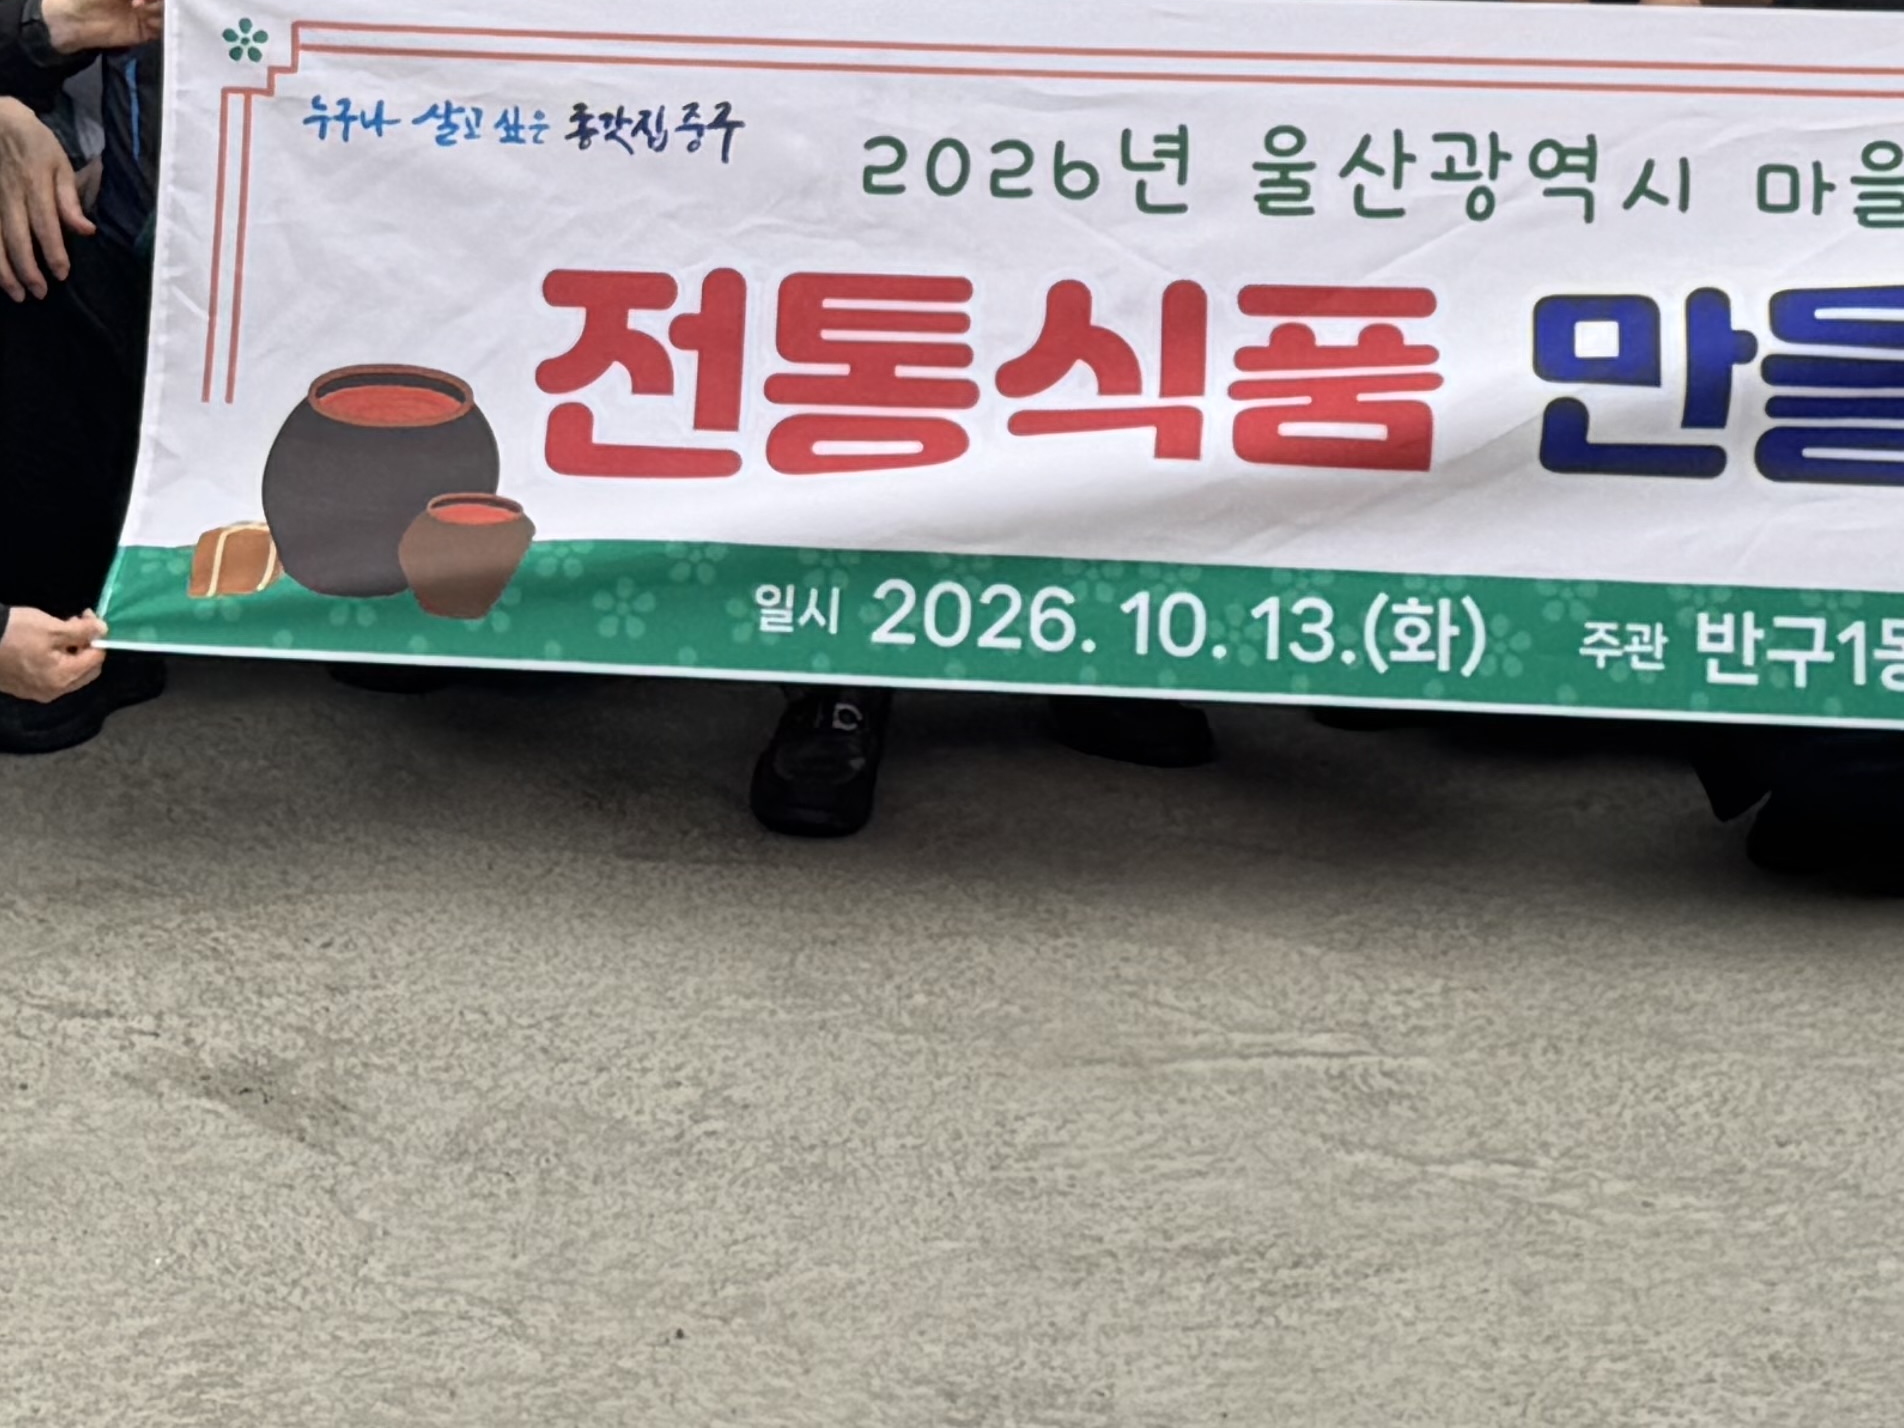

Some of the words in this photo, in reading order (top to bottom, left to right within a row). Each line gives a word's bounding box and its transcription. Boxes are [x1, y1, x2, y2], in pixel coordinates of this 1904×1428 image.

[302, 95, 401, 143] 누구나
[411, 99, 483, 147] 살고
[494, 105, 550, 144] 싶은
[564, 101, 669, 156] 종갓집
[673, 100, 746, 164] 중구
[861, 124, 1191, 216] 2026년
[1251, 124, 1691, 224] 울산광역시
[534, 266, 1444, 478] 전통식품
[753, 582, 841, 635] 일시
[870, 578, 1097, 654] 2026.
[1119, 591, 1228, 660] 10.
[1249, 591, 1487, 678] 13.(화)
[1578, 620, 1669, 673] 주관
